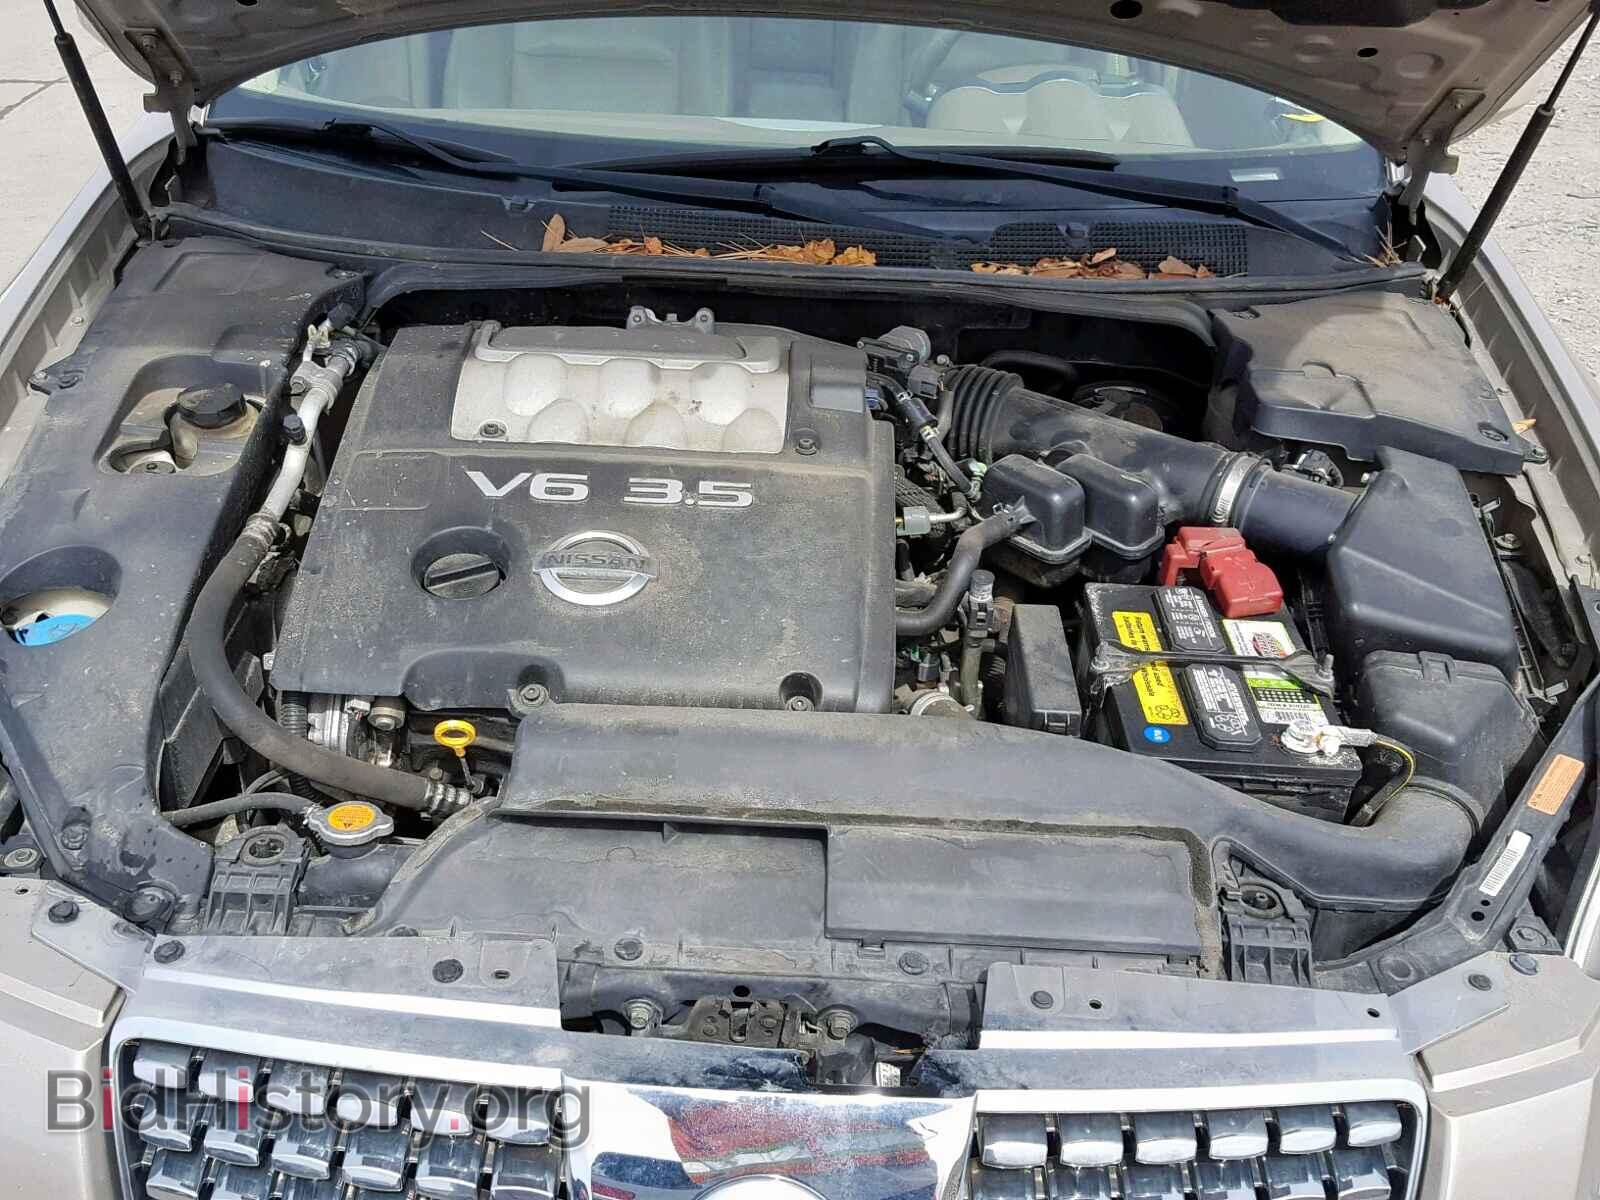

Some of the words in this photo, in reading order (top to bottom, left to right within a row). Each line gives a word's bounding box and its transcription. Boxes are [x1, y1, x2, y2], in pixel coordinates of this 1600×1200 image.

[465, 471, 589, 501] V6
[624, 477, 754, 508] 3.5
[542, 552, 646, 570] NISSAN
